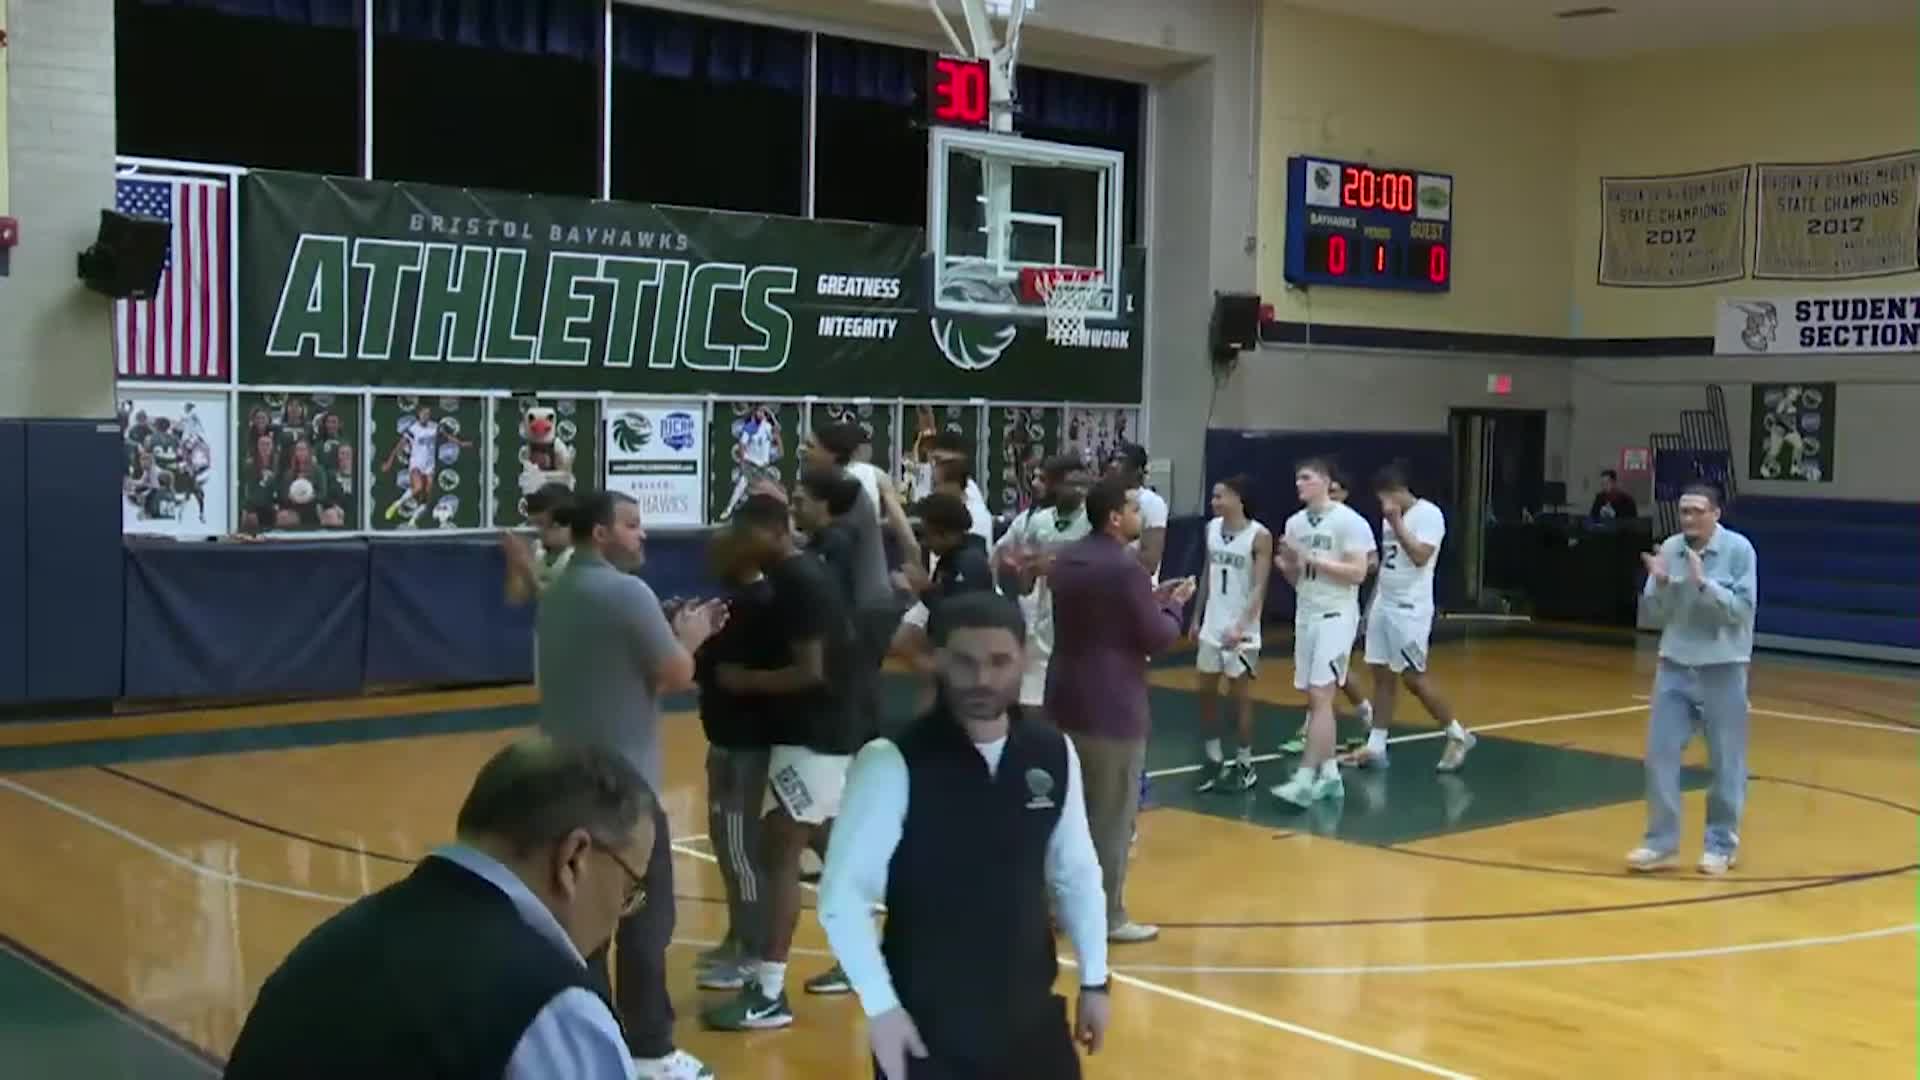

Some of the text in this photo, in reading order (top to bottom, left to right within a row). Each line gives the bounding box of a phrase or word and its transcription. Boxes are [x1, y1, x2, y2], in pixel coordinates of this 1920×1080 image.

[936, 60, 985, 120] 30
[1344, 168, 1413, 211] 20:00
[1777, 190, 1899, 213] STATE CHAMPIONS
[1310, 212, 1357, 229] BAYHAWKS
[1620, 202, 1728, 224] STATE CHAMPIONS
[409, 214, 688, 250] BRISTOL BAYHAWKS
[1410, 221, 1444, 240] GUEST
[1646, 228, 1696, 245] 2017
[1808, 217, 1864, 235] 2017
[1328, 235, 1346, 276] 0
[1377, 245, 1384, 272] 1
[1430, 244, 1447, 284] 0
[817, 273, 901, 299] GREATNESS
[265, 234, 798, 373] ATHLETICS
[818, 316, 898, 339] INTEGRITY
[1799, 323, 1920, 348] SECTION
[638, 495, 688, 513] HAWKS
[1221, 568, 1228, 596] 1
